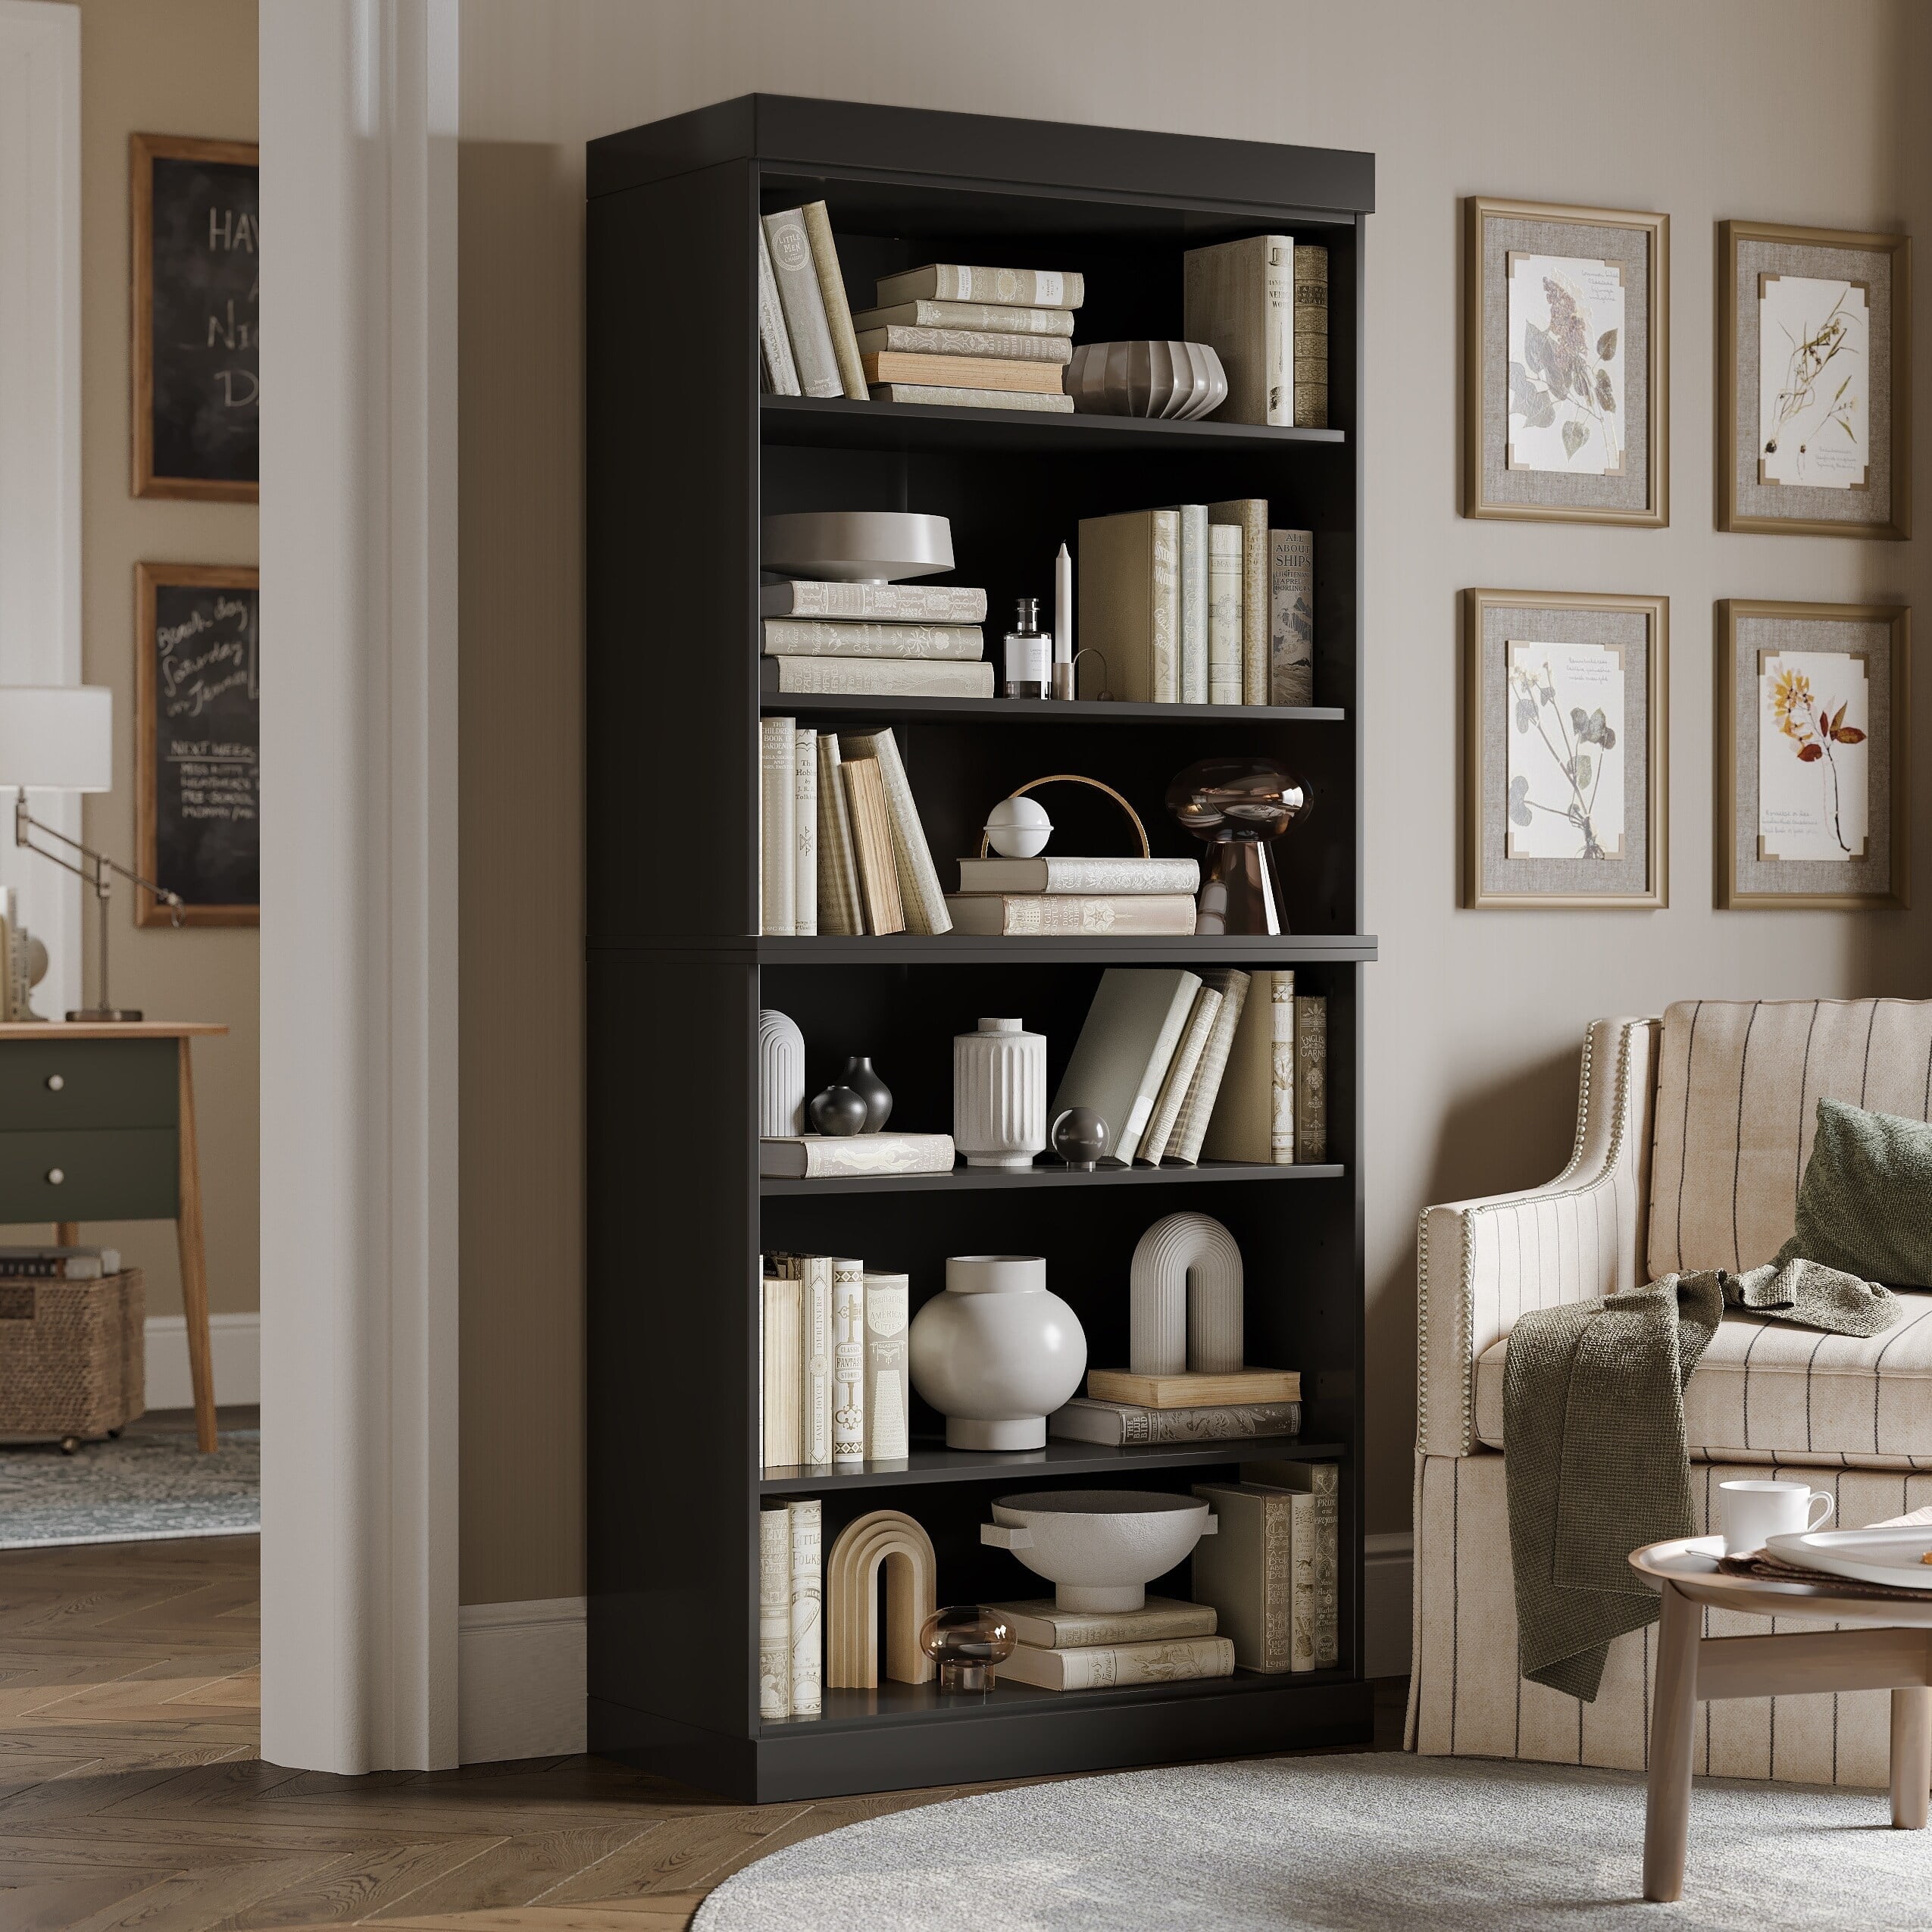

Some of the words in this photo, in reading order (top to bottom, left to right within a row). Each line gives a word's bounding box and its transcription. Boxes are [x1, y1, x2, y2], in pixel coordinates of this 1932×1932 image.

[778, 233, 801, 244] LITTLE
[783, 242, 801, 253] MEN
[1286, 534, 1304, 542] ALL
[1275, 544, 1310, 554] ABOUT
[1275, 555, 1311, 568] SHIPS
[774, 628, 784, 643] The
[787, 627, 799, 652] Vicar
[811, 621, 823, 656] Wakefield
[1043, 896, 1052, 936] ENGLISH
[1049, 896, 1058, 936] COSTUME
[874, 1321, 902, 1330] CITIES
[792, 1532, 821, 1549] LITTLE
[792, 1551, 821, 1570] FOLKS
